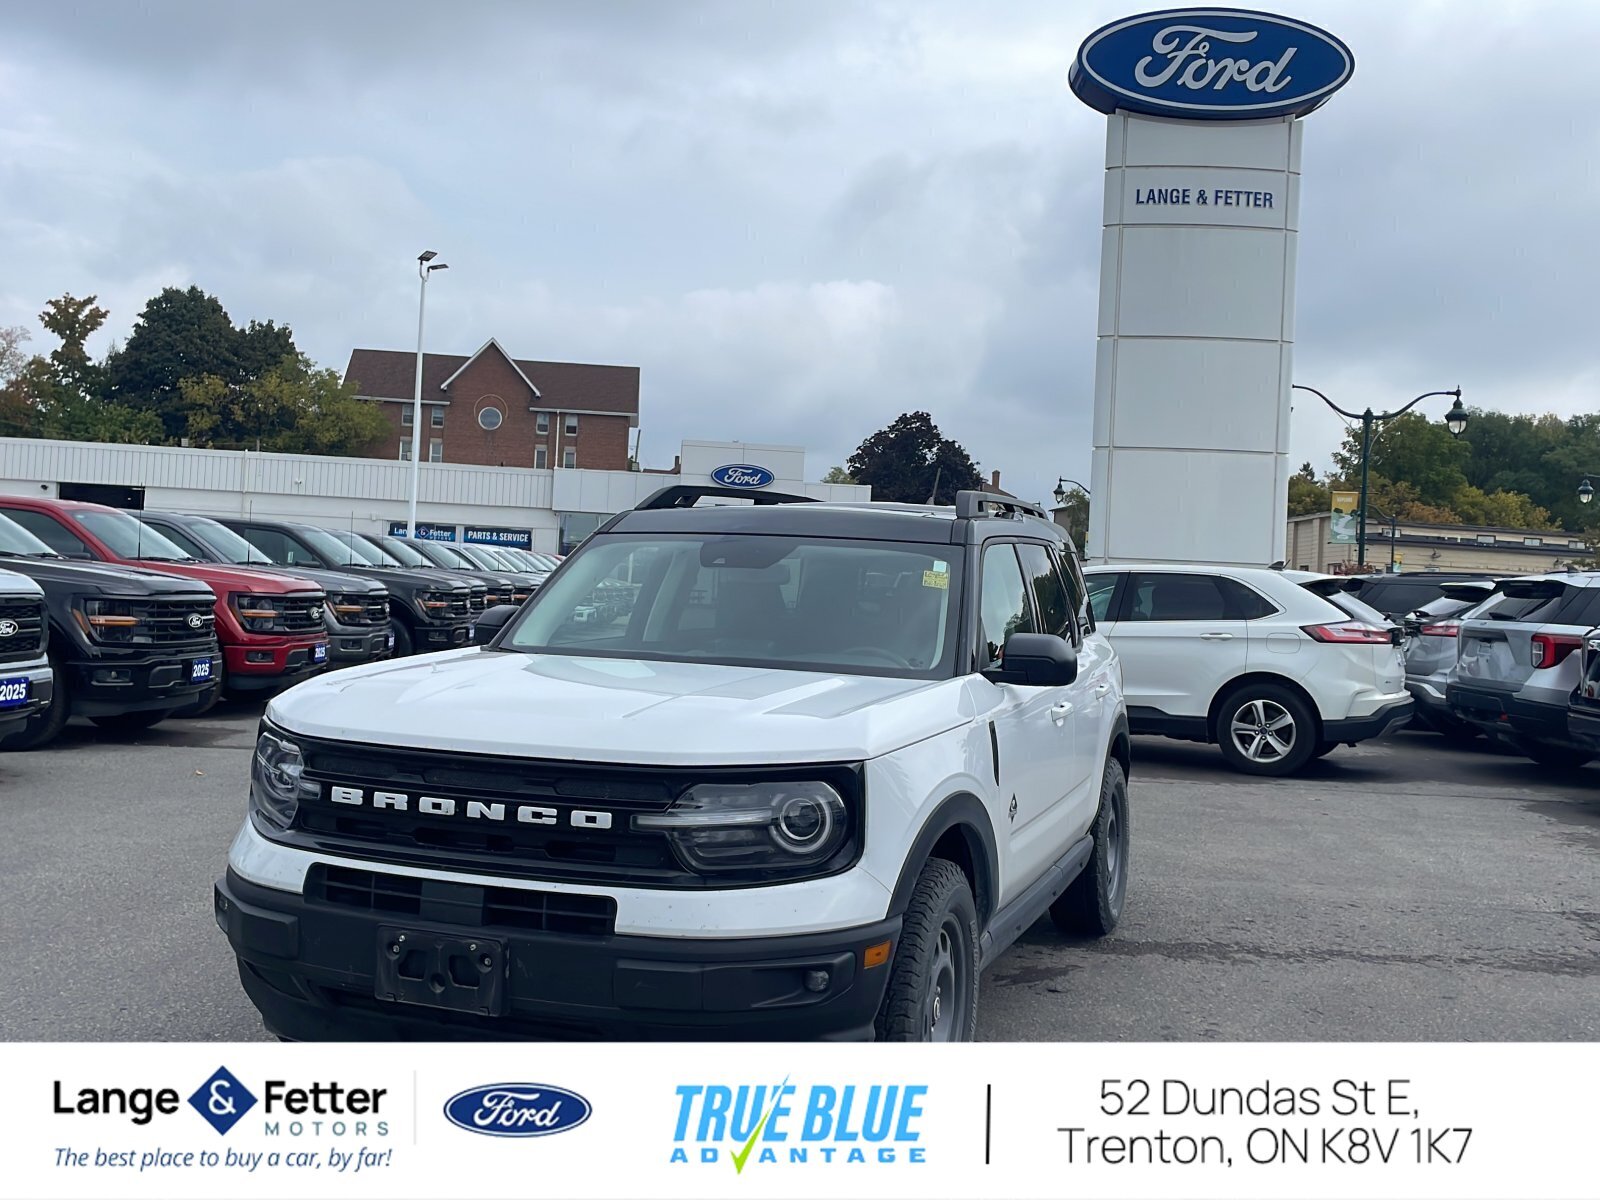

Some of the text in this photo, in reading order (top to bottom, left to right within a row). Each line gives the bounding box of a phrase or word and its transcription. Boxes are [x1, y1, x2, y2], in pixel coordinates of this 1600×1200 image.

[1134, 24, 1298, 93] Ford
[1136, 188, 1274, 209] LANGE & FETTER
[724, 467, 762, 484] Ford
[467, 530, 528, 542] PARTS & SERVICE
[192, 664, 210, 677] 2025
[0, 683, 27, 701] 2025
[331, 786, 612, 829] BRONCO
